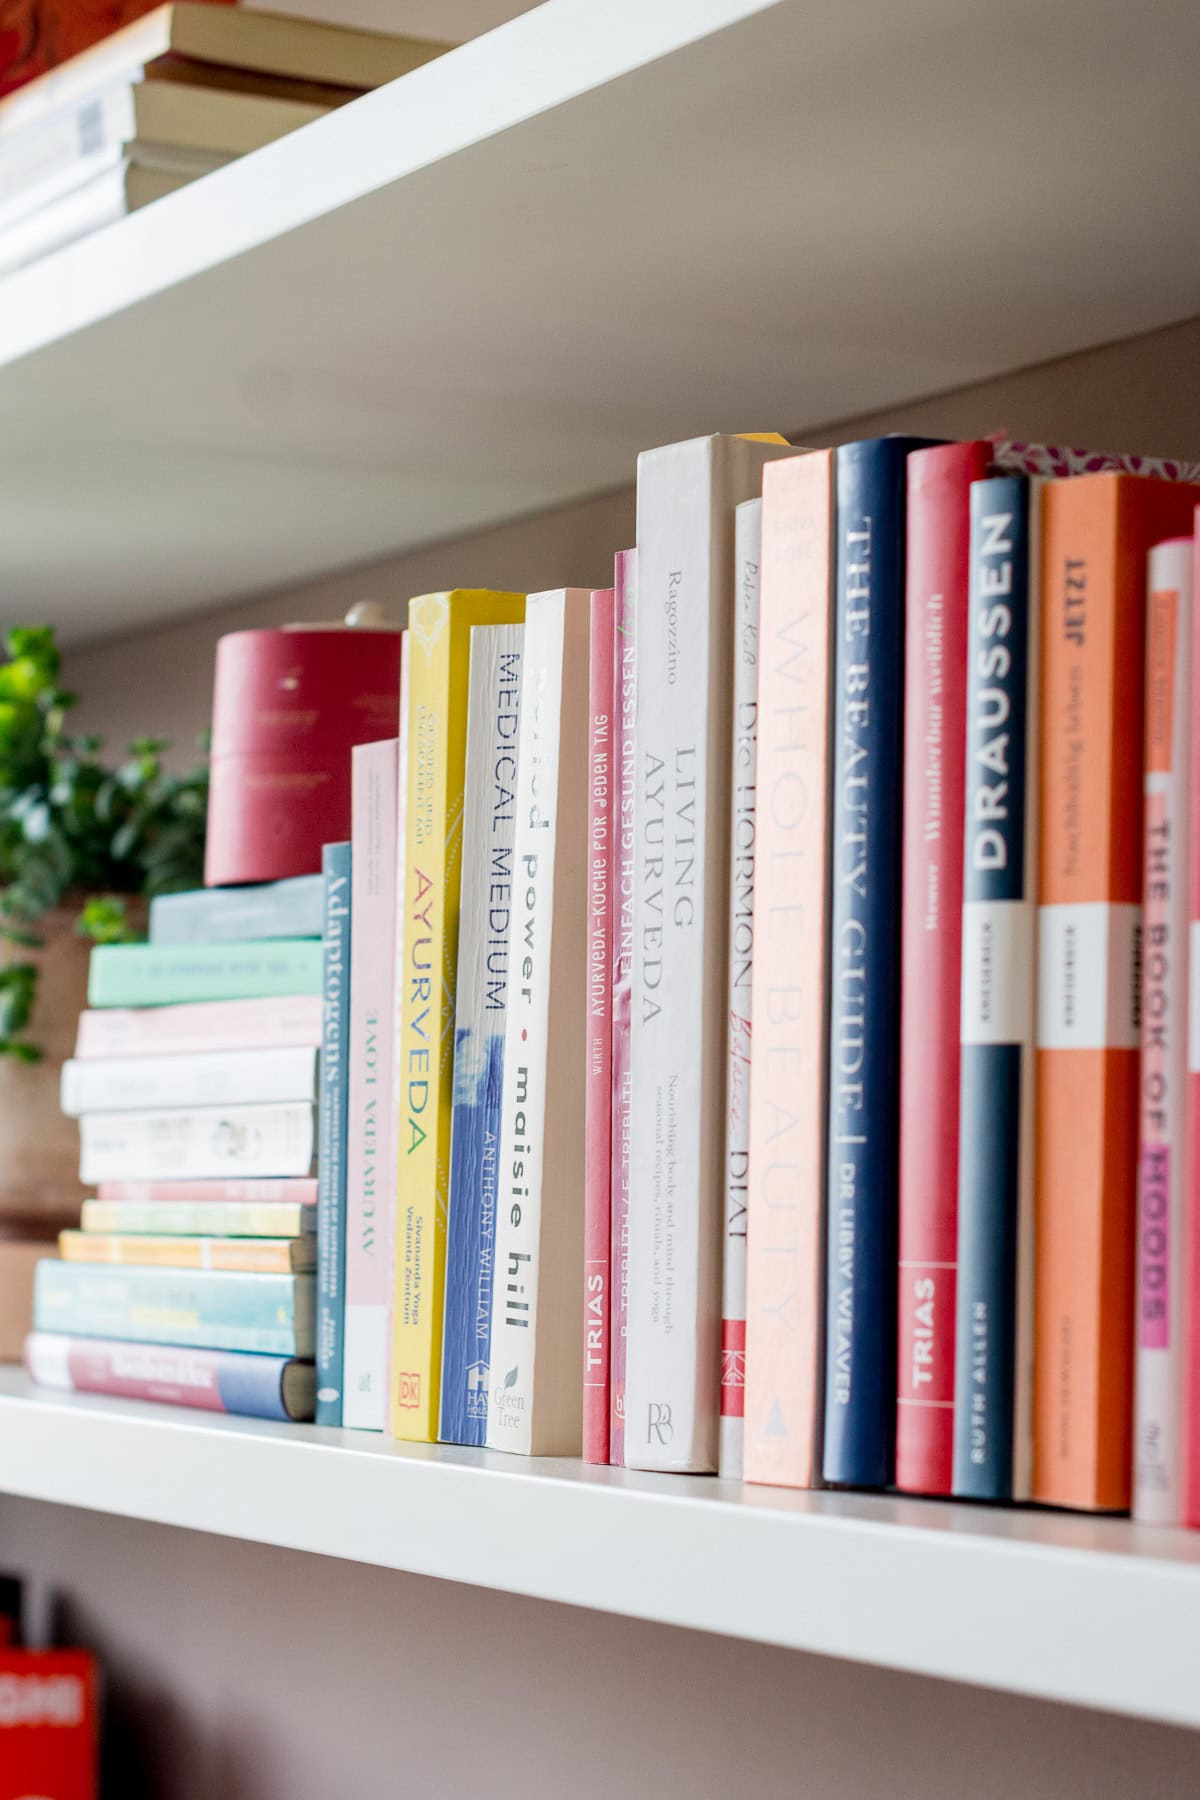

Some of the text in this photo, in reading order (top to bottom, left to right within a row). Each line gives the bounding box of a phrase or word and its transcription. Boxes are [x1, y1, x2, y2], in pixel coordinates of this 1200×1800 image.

[664, 570, 683, 686] Ragozzino
[925, 593, 944, 697] weiblich
[1062, 557, 1087, 647] JETZT
[594, 713, 609, 745] TAG
[621, 646, 637, 730] ESSEN
[738, 702, 758, 768] Die
[973, 512, 1014, 871] DRAUSSEN
[485, 653, 521, 1011] MEDICAL MEDIUM
[621, 739, 636, 850] GESUND
[673, 744, 696, 930] LIVING
[769, 611, 810, 938] WHOLE
[835, 515, 872, 1114] THE BEAUTY GUIDE
[923, 704, 943, 843] Wunderbar
[521, 854, 540, 1005] power
[642, 752, 666, 1028] AYURVEDA
[733, 784, 756, 988] HORMON
[323, 869, 350, 1081] Adaptogens
[407, 866, 434, 1156] AYURVEDA
[592, 1037, 604, 1075] WIRTH
[654, 1085, 665, 1144] seasonal
[1142, 817, 1171, 1323] THE BOOK OF MOODS
[361, 1007, 379, 1257] AYURVEDA LOVE
[509, 1066, 532, 1229] maisie
[760, 985, 804, 1332] BEAUTY
[403, 1206, 415, 1326] Vedanta Zentrum
[474, 1131, 498, 1340] ANTHONY WILLIAM
[662, 1074, 679, 1335] Nourishing body and mind through
[410, 1215, 424, 1326] Sivananda Yoga
[505, 1251, 532, 1328] hill
[587, 1273, 604, 1373] TRIAS
[650, 1290, 662, 1324] yoga
[653, 1258, 663, 1286] and
[833, 1162, 857, 1406] DR LIBBY WEAVER
[911, 1277, 937, 1390] TRIAS
[400, 1381, 418, 1400] DK
[495, 1386, 524, 1410] Green
[497, 1406, 521, 1429] Tree
[970, 1301, 988, 1465] RUTH ALLEN
